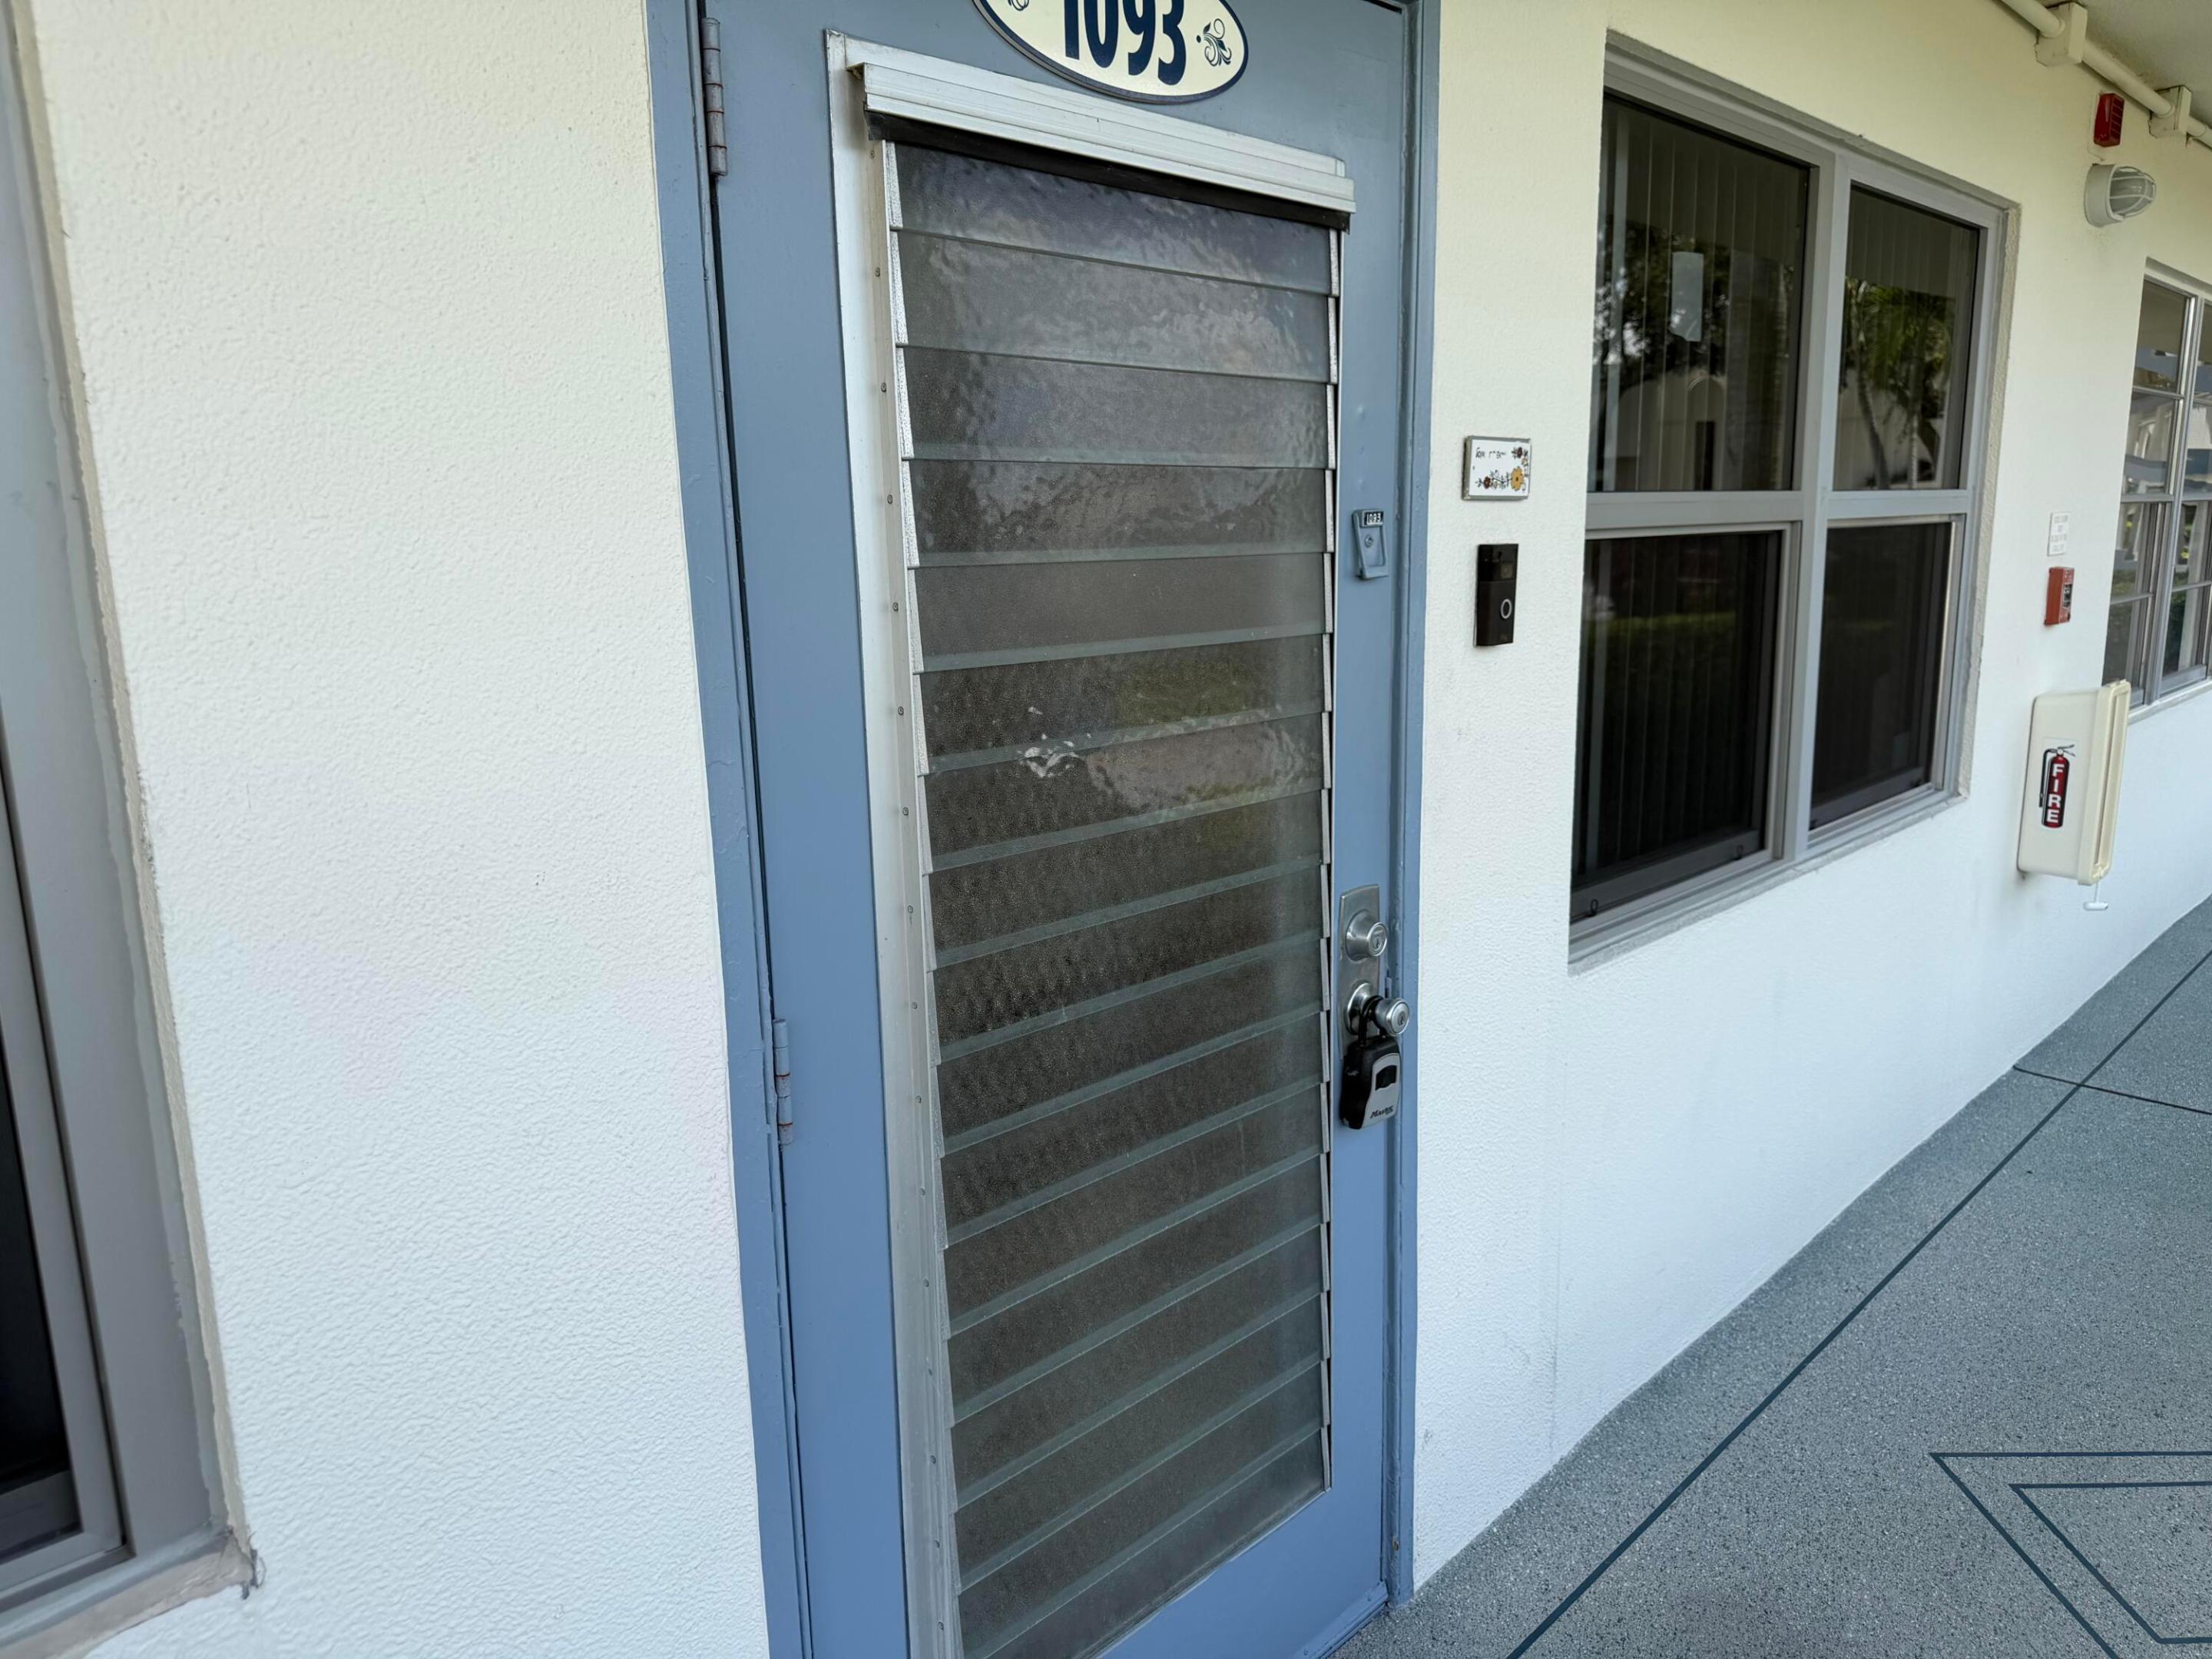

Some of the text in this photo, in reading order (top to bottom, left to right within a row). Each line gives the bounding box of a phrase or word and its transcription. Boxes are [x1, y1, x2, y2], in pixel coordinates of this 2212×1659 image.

[1065, 0, 1187, 85] 1093
[1366, 513, 1381, 523] 1093
[2046, 763, 2065, 823] FIRE
